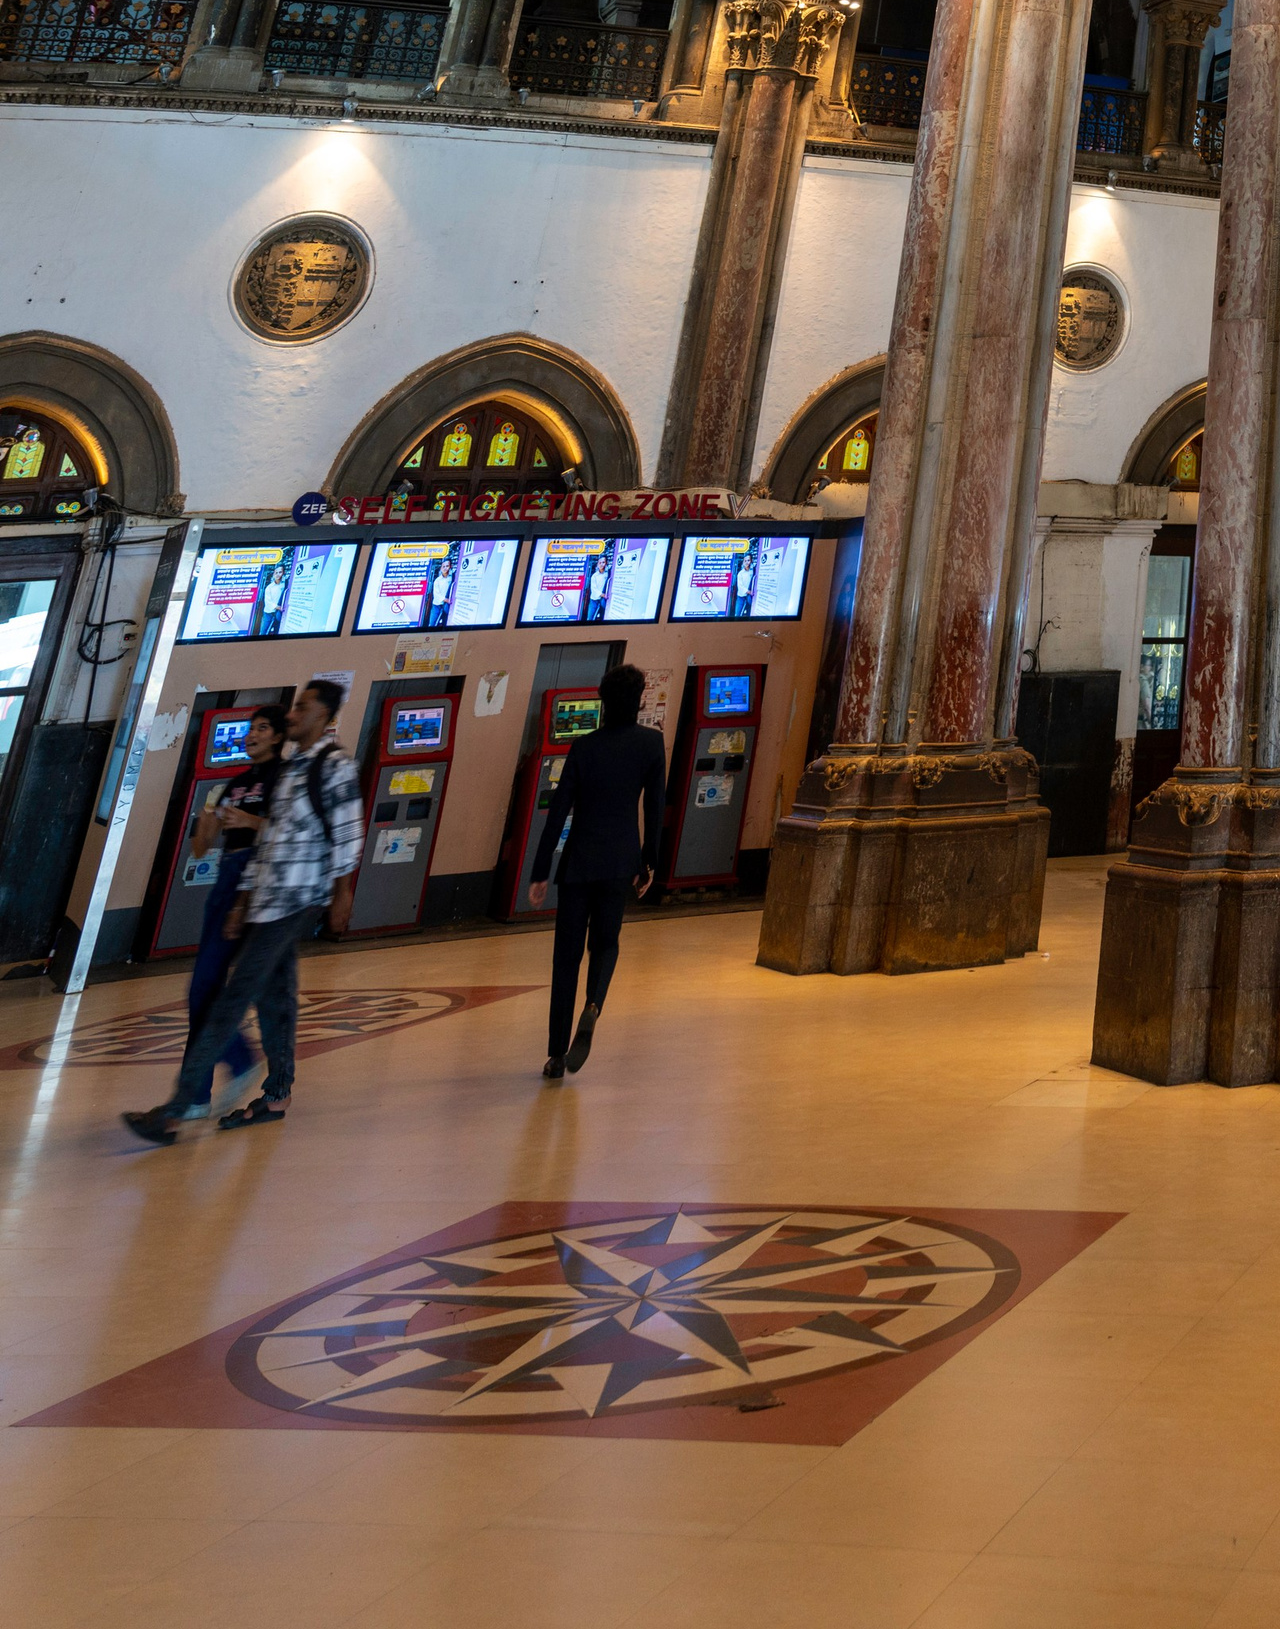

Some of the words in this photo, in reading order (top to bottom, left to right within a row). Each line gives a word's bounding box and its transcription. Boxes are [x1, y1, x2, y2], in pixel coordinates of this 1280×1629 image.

[301, 503, 327, 515] ZEE
[332, 495, 428, 526] SELF
[438, 493, 621, 523] TICKETING
[631, 493, 721, 521] ZONE
[113, 745, 144, 826] VYOMA
